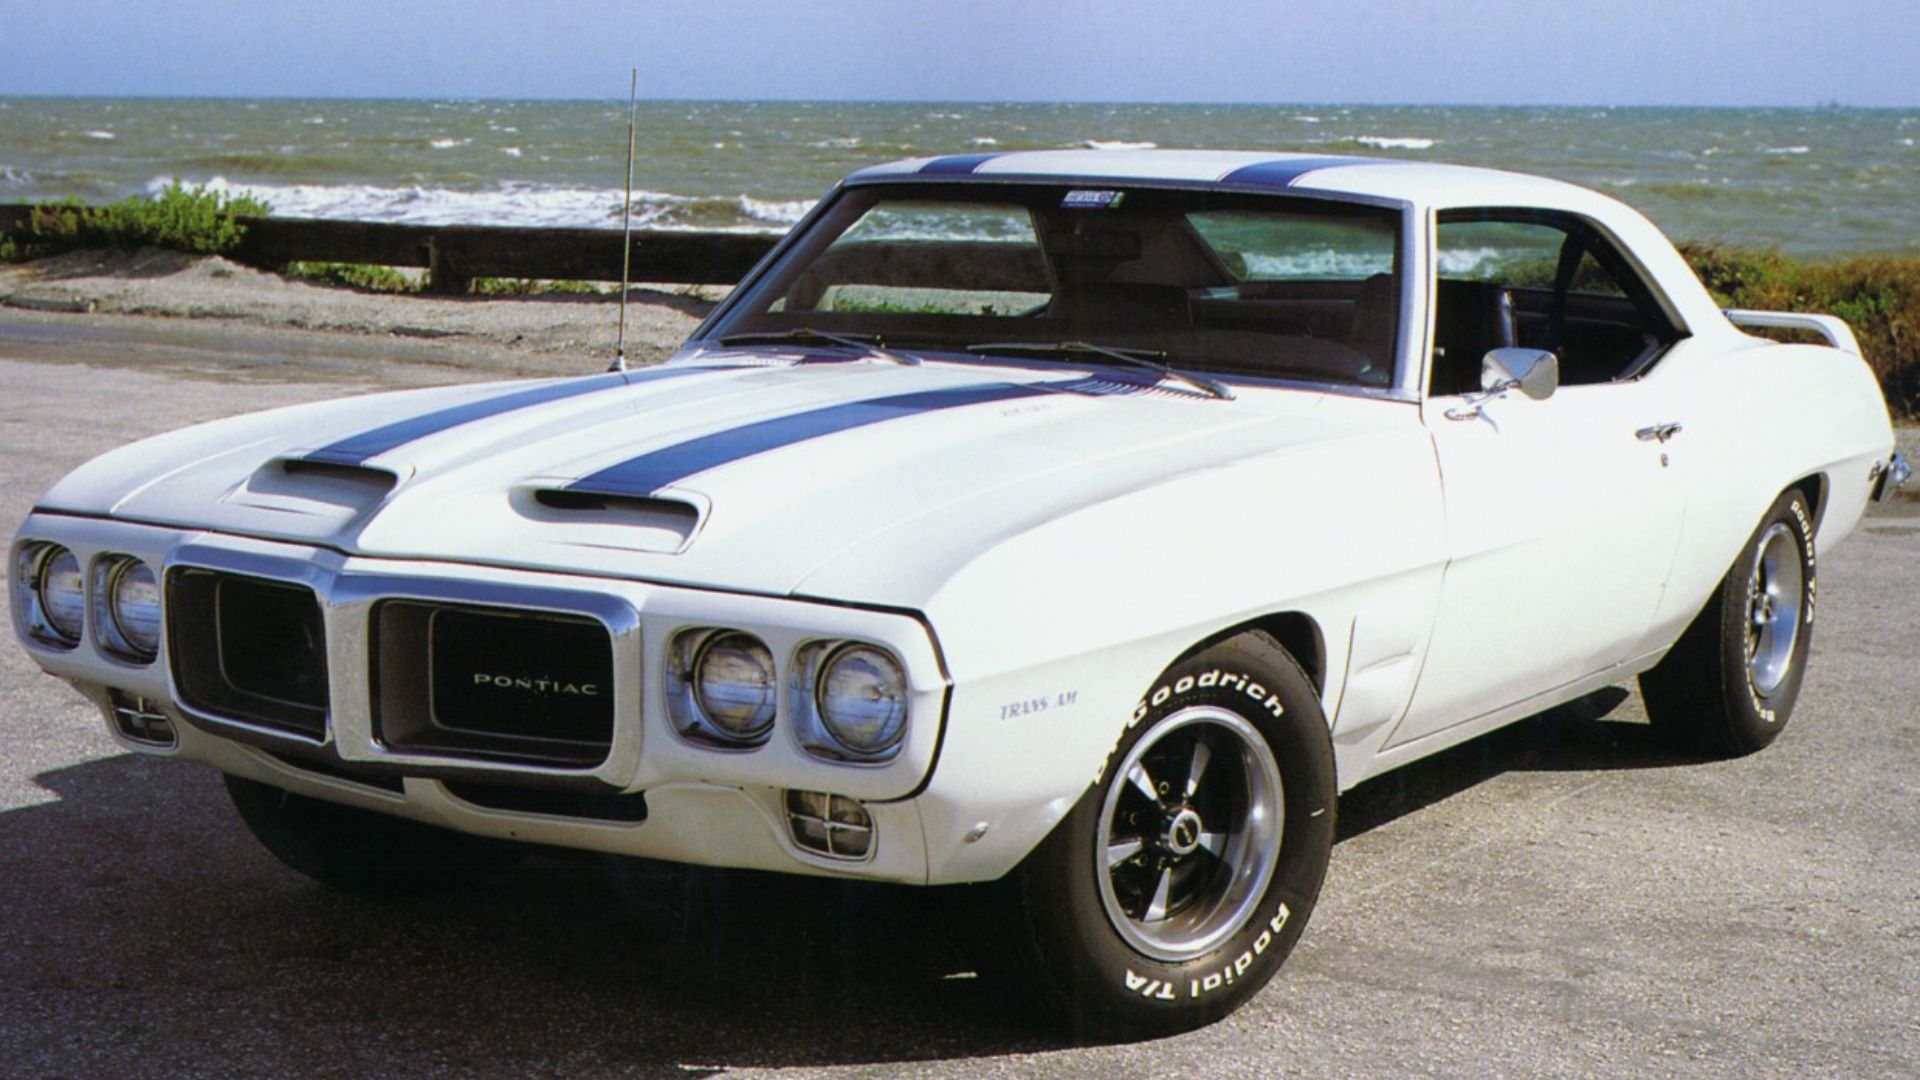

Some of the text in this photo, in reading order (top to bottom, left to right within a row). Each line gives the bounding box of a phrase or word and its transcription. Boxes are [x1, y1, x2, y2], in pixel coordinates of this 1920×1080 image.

[1790, 500, 1815, 567] Radial
[474, 672, 599, 696] PONTIAC
[1000, 690, 1079, 721] TRANS AM
[1125, 901, 1291, 1000] Radial T/A
